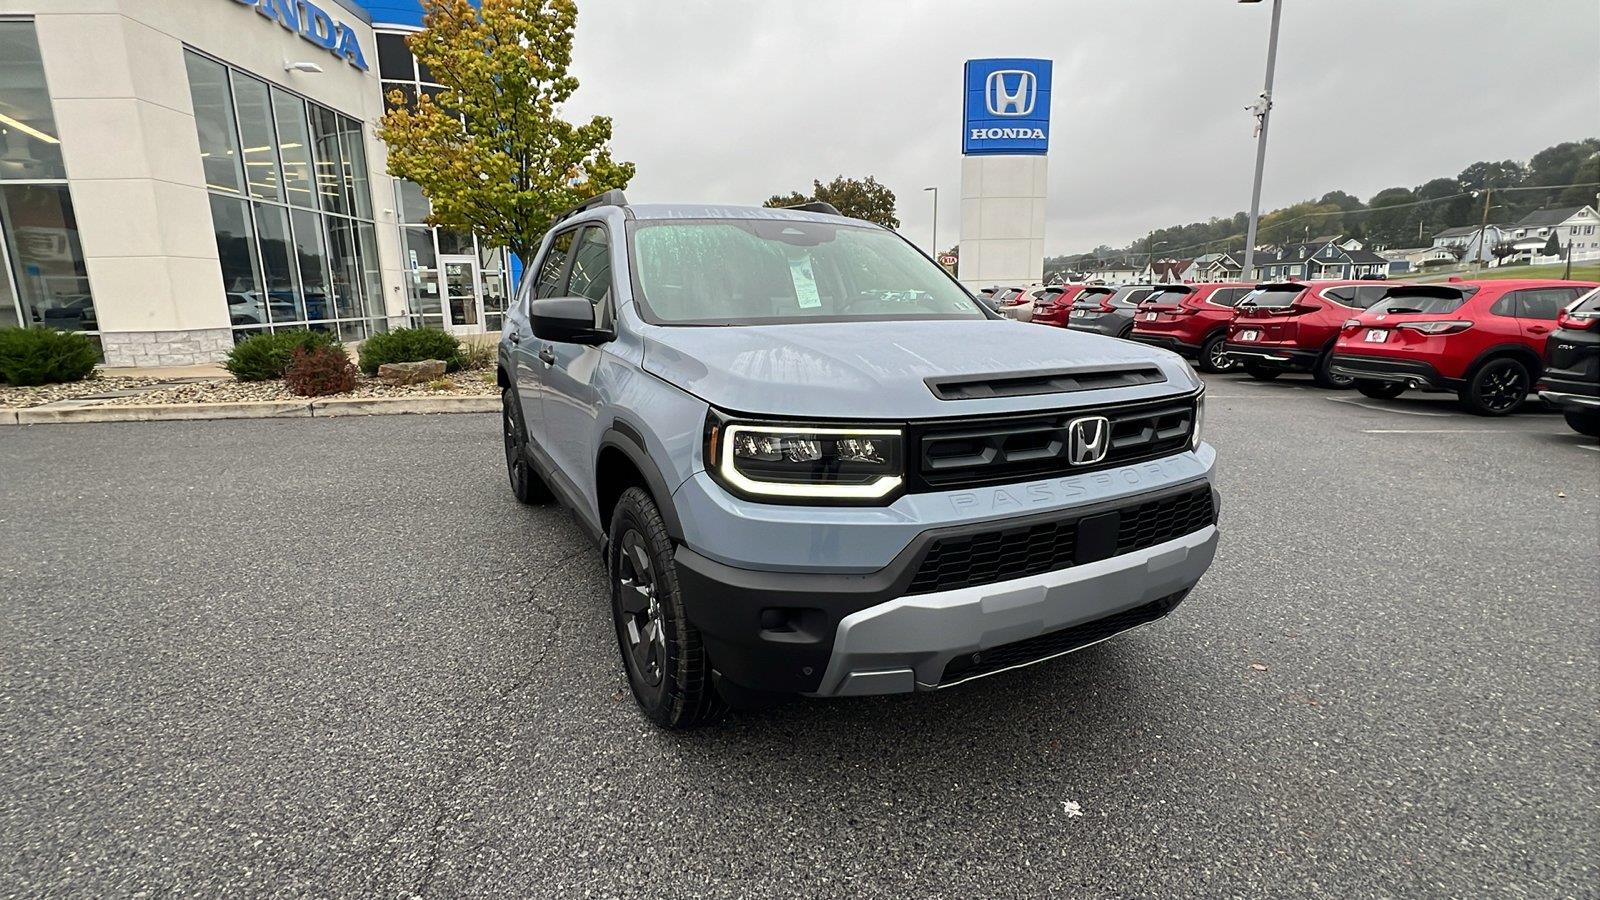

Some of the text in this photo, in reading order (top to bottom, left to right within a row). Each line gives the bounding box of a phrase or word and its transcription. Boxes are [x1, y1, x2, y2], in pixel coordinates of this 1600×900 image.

[231, 0, 369, 71] NDA
[970, 128, 1046, 139] HONDA
[948, 456, 1182, 515] PASSPORT
